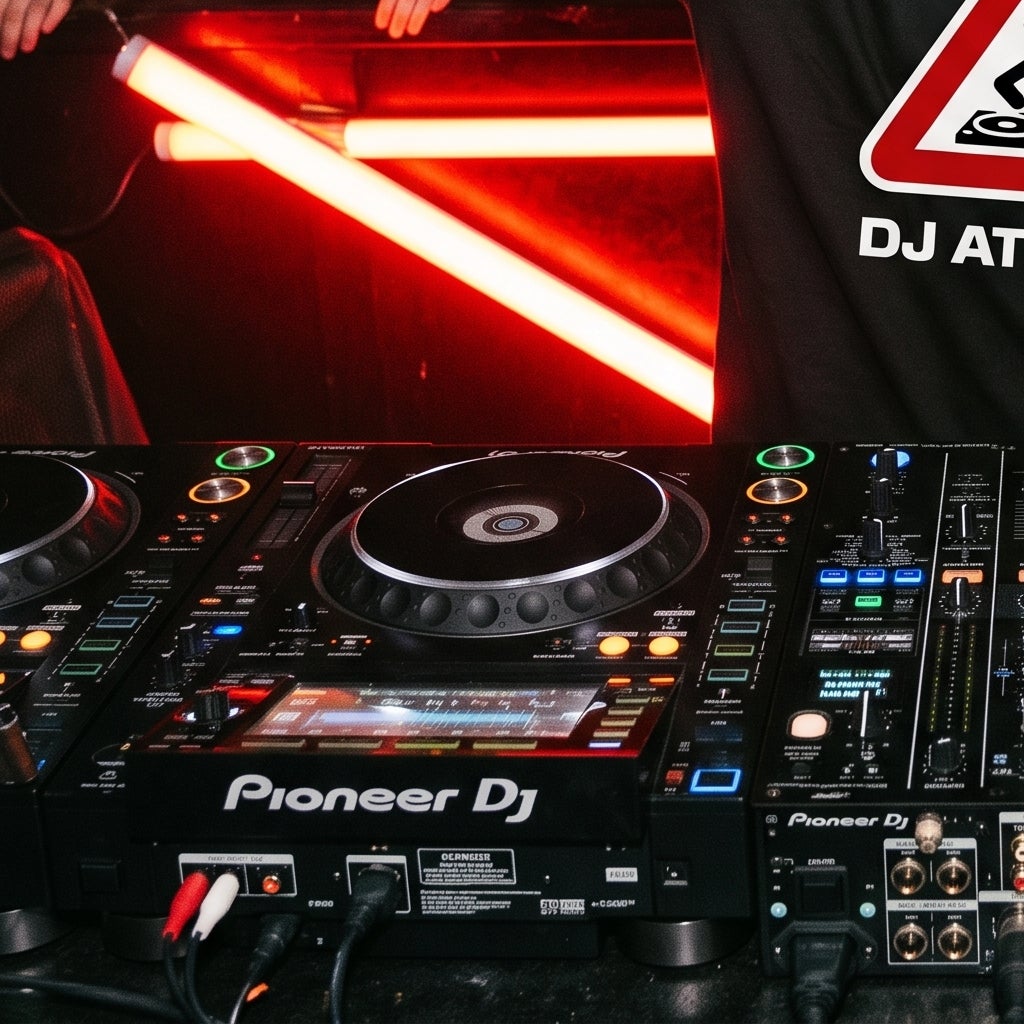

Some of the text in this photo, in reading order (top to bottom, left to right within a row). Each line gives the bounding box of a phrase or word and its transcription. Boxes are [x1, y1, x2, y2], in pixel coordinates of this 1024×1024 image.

[858, 216, 937, 262] DJ
[223, 774, 460, 811] Pioneer
[787, 812, 879, 827] Pioneer
